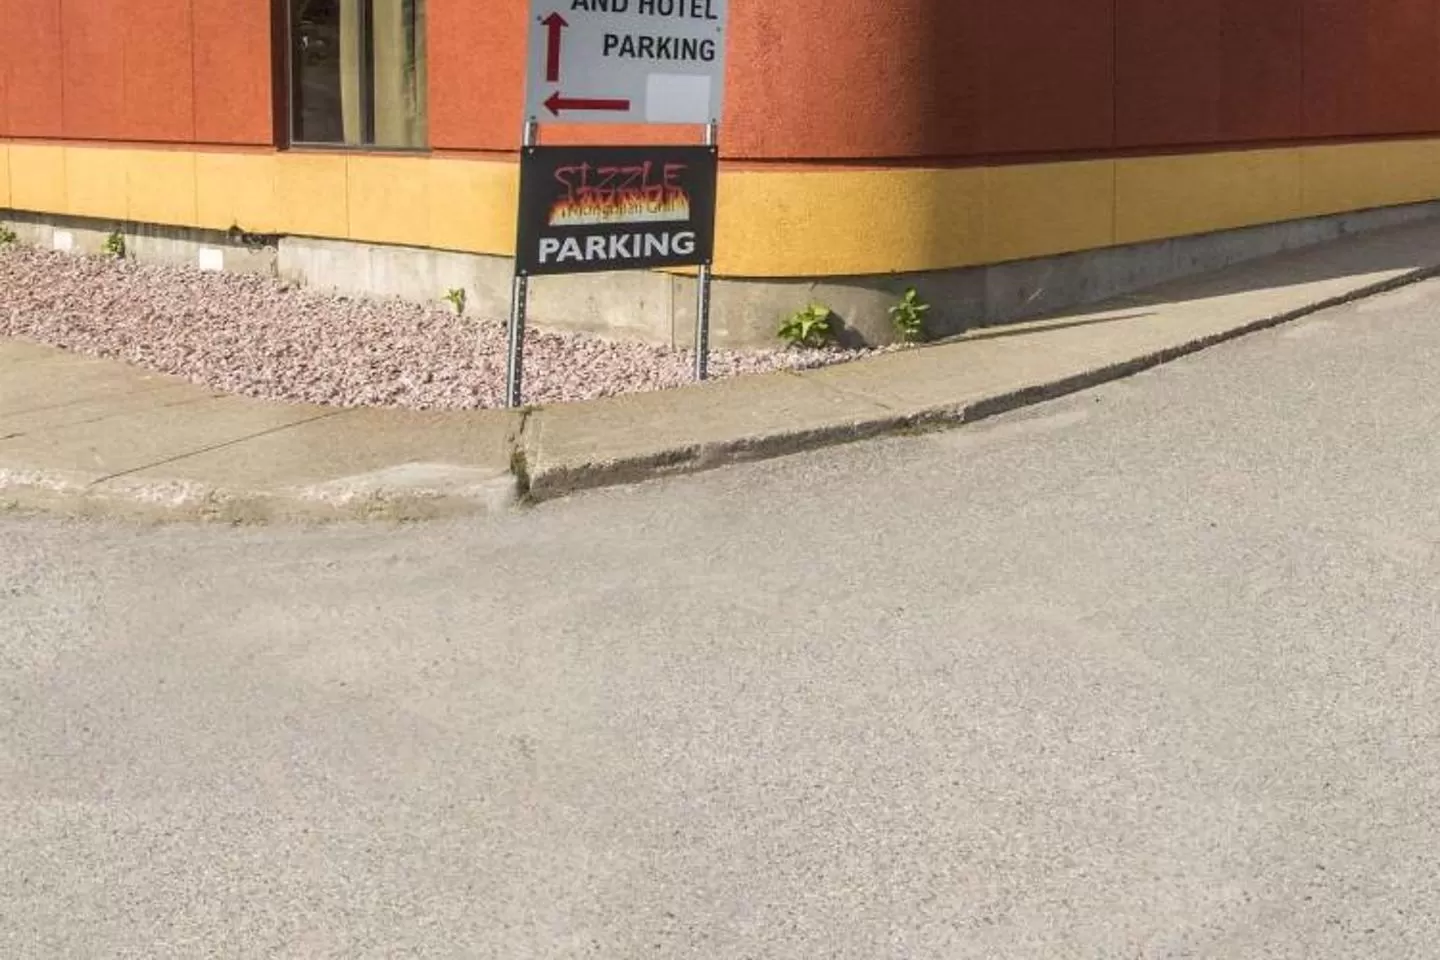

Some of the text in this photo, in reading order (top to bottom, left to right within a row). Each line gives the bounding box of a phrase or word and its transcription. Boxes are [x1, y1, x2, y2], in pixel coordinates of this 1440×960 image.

[602, 33, 716, 62] PARKING
[554, 160, 688, 197] SIZZLE
[538, 231, 696, 264] PARKING
